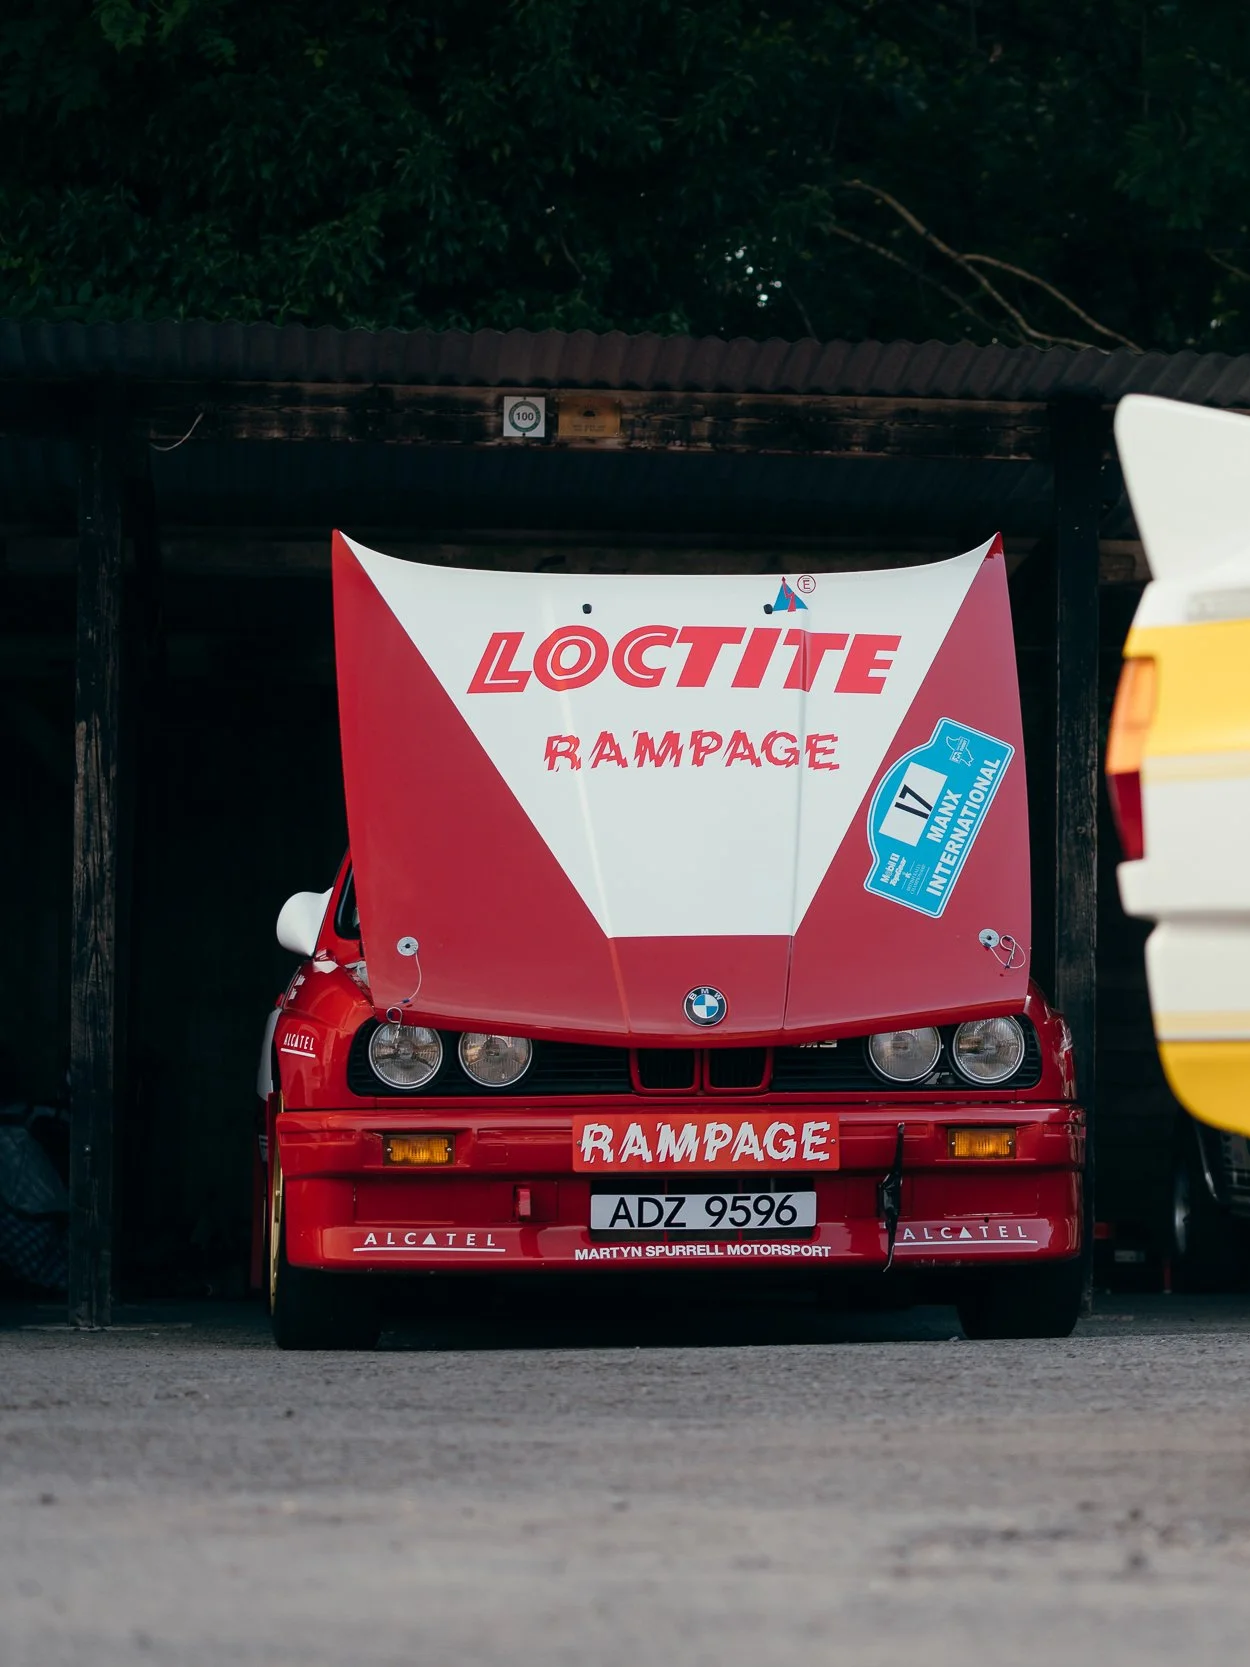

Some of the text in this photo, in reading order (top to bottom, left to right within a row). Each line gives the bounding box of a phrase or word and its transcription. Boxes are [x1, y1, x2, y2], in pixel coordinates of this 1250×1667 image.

[516, 412, 534, 421] 100
[467, 625, 902, 694] LOCTITE
[543, 729, 840, 772] RAMPAGE
[895, 783, 933, 819] 17
[926, 789, 962, 843] MANX
[926, 759, 1001, 896] INTERNATIONAL
[689, 988, 722, 1000] BMW
[283, 1032, 314, 1051] ALCATEL
[577, 1120, 832, 1164] RAMPAGE
[609, 1194, 798, 1228] ADZ 9596
[364, 1232, 496, 1247] ALCATEL
[902, 1225, 1028, 1240] ALCATEL
[575, 1244, 831, 1260] MARTYN SPURRELL MOTORSPORT
